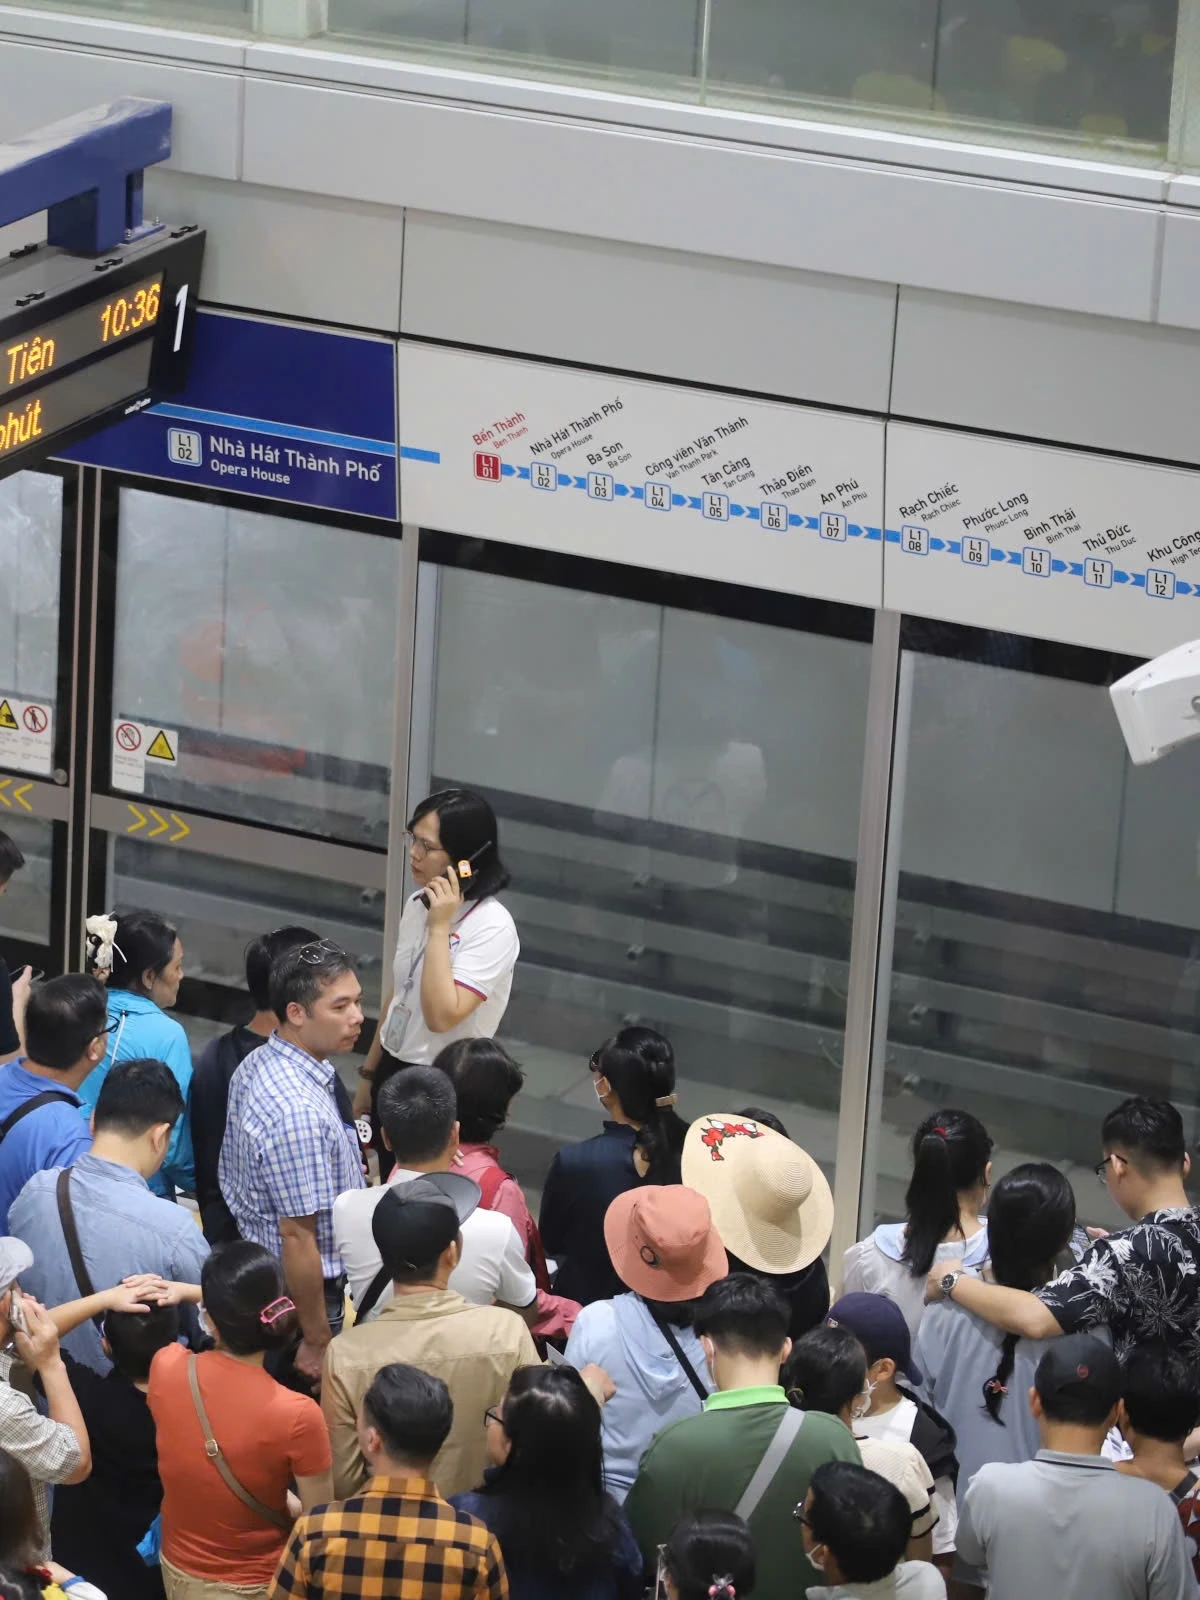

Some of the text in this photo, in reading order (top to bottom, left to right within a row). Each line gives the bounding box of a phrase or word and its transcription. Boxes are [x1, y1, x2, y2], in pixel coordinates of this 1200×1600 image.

[100, 283, 161, 341] 10:36
[173, 284, 188, 352] 1
[7, 336, 55, 384] Tiên
[472, 411, 526, 446] Bến Thành
[529, 396, 624, 456] Nhà Hát Thành Phố
[178, 434, 191, 447] L1
[550, 433, 594, 460] Opera House
[645, 416, 749, 477] Công viên Văn Thánh
[178, 447, 192, 460] 02
[210, 436, 382, 482] Nhà Hát Thành Phố
[586, 440, 624, 466] Ba Son
[607, 452, 633, 469] Ba Son
[481, 457, 494, 468] L1
[665, 449, 719, 480] Van Thanh Park
[211, 459, 290, 484] Opera House
[482, 468, 493, 478] 01
[538, 465, 550, 477] L1
[701, 456, 752, 487] Tân Cảng
[537, 477, 550, 488] 02
[595, 475, 606, 487] L1
[722, 470, 756, 490] Tan Cang
[759, 477, 788, 497] Thảo
[594, 486, 607, 498] 03
[652, 486, 663, 497] L1
[781, 477, 817, 500] Thao Dien
[819, 477, 860, 505] An Phú
[651, 497, 664, 508] 04
[710, 495, 721, 507] L1
[841, 491, 868, 509] An Phu
[899, 482, 959, 518] Rạch Chiếc
[709, 506, 722, 518] 05
[769, 506, 780, 517] L1
[921, 498, 962, 522] Rach Chiec
[962, 492, 1029, 530] Phước Long
[768, 517, 781, 528] 06
[828, 516, 839, 527] L1
[984, 508, 1029, 534] Phuoc Long
[1023, 507, 1077, 541] Bình Thái
[827, 527, 840, 538] 07
[910, 529, 921, 541] L1
[1045, 522, 1082, 545] Binh Thai
[1082, 523, 1132, 552] Thủ Đức
[908, 541, 922, 552] 08
[970, 540, 982, 551] L1
[1105, 536, 1137, 555] Thu Duc
[969, 551, 982, 563] 09
[1031, 551, 1043, 562] L1
[1146, 545, 1173, 562] Khu
[1170, 552, 1190, 566] High
[1031, 563, 1042, 574] 10
[1092, 562, 1105, 573] L1
[1094, 574, 1103, 585] 11
[1155, 573, 1167, 584] L1
[1155, 584, 1166, 595] 12
